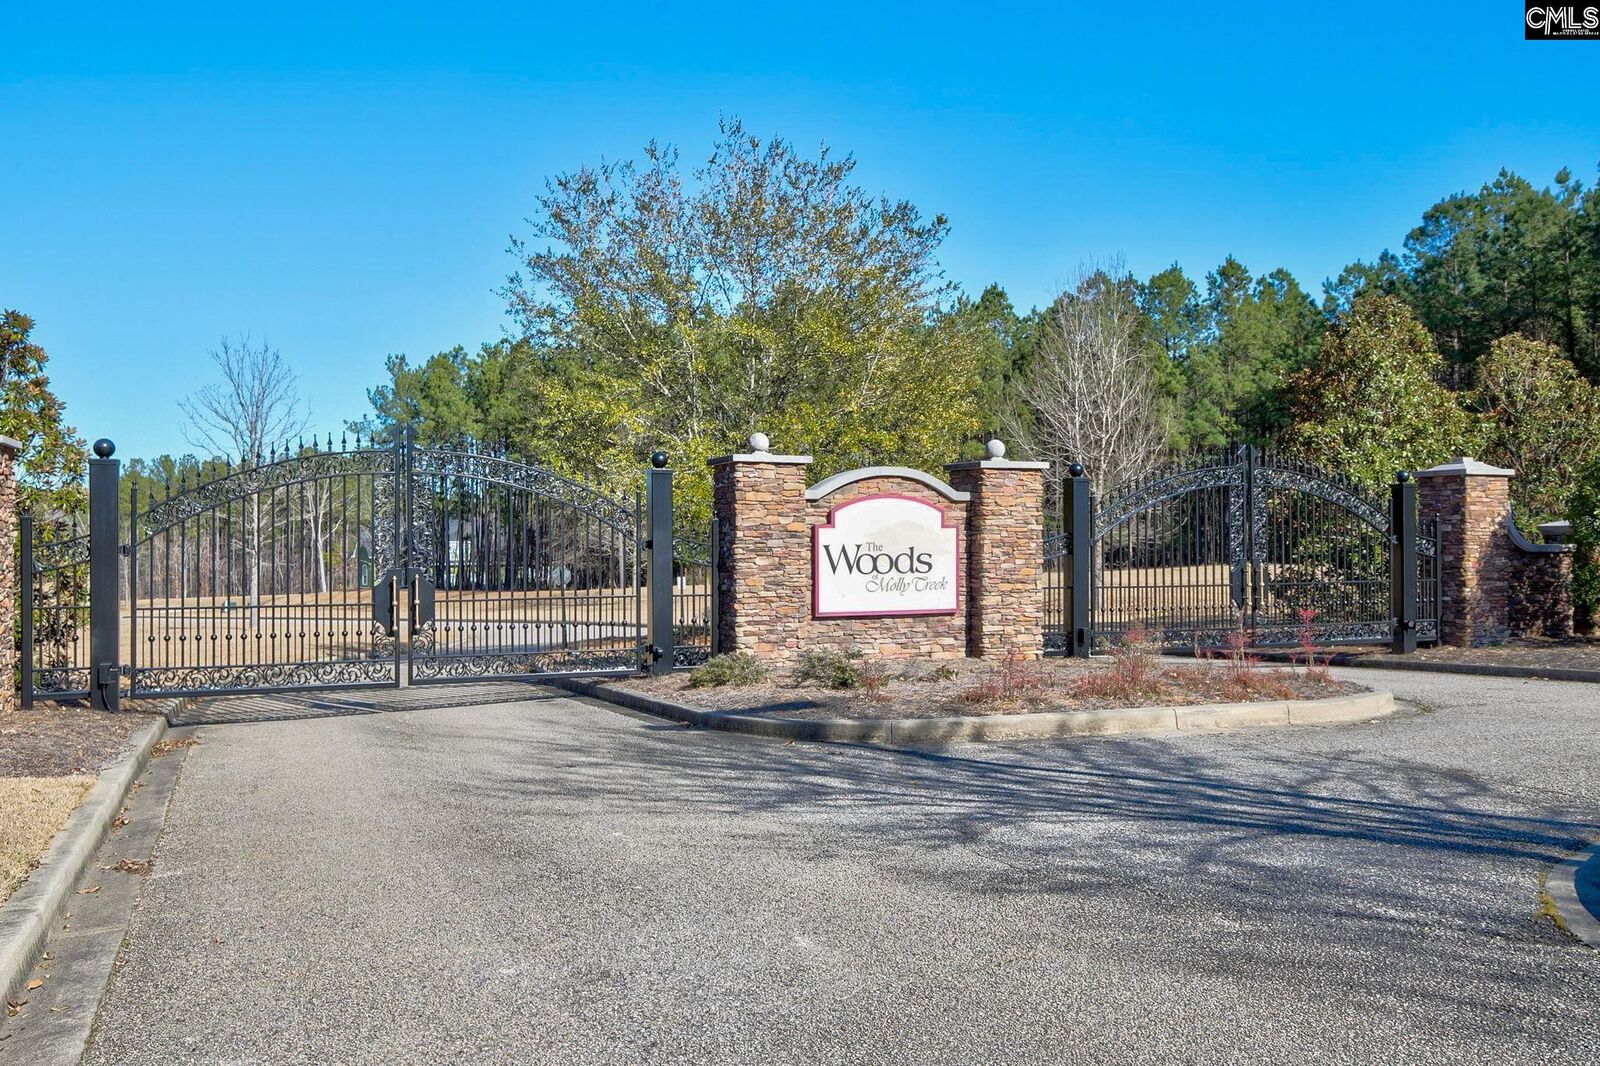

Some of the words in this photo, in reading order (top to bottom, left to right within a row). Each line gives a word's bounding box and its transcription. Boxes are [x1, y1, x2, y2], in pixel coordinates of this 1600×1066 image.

[866, 542, 883, 552] The
[823, 543, 933, 575] Woods
[865, 576, 911, 596] Molly
